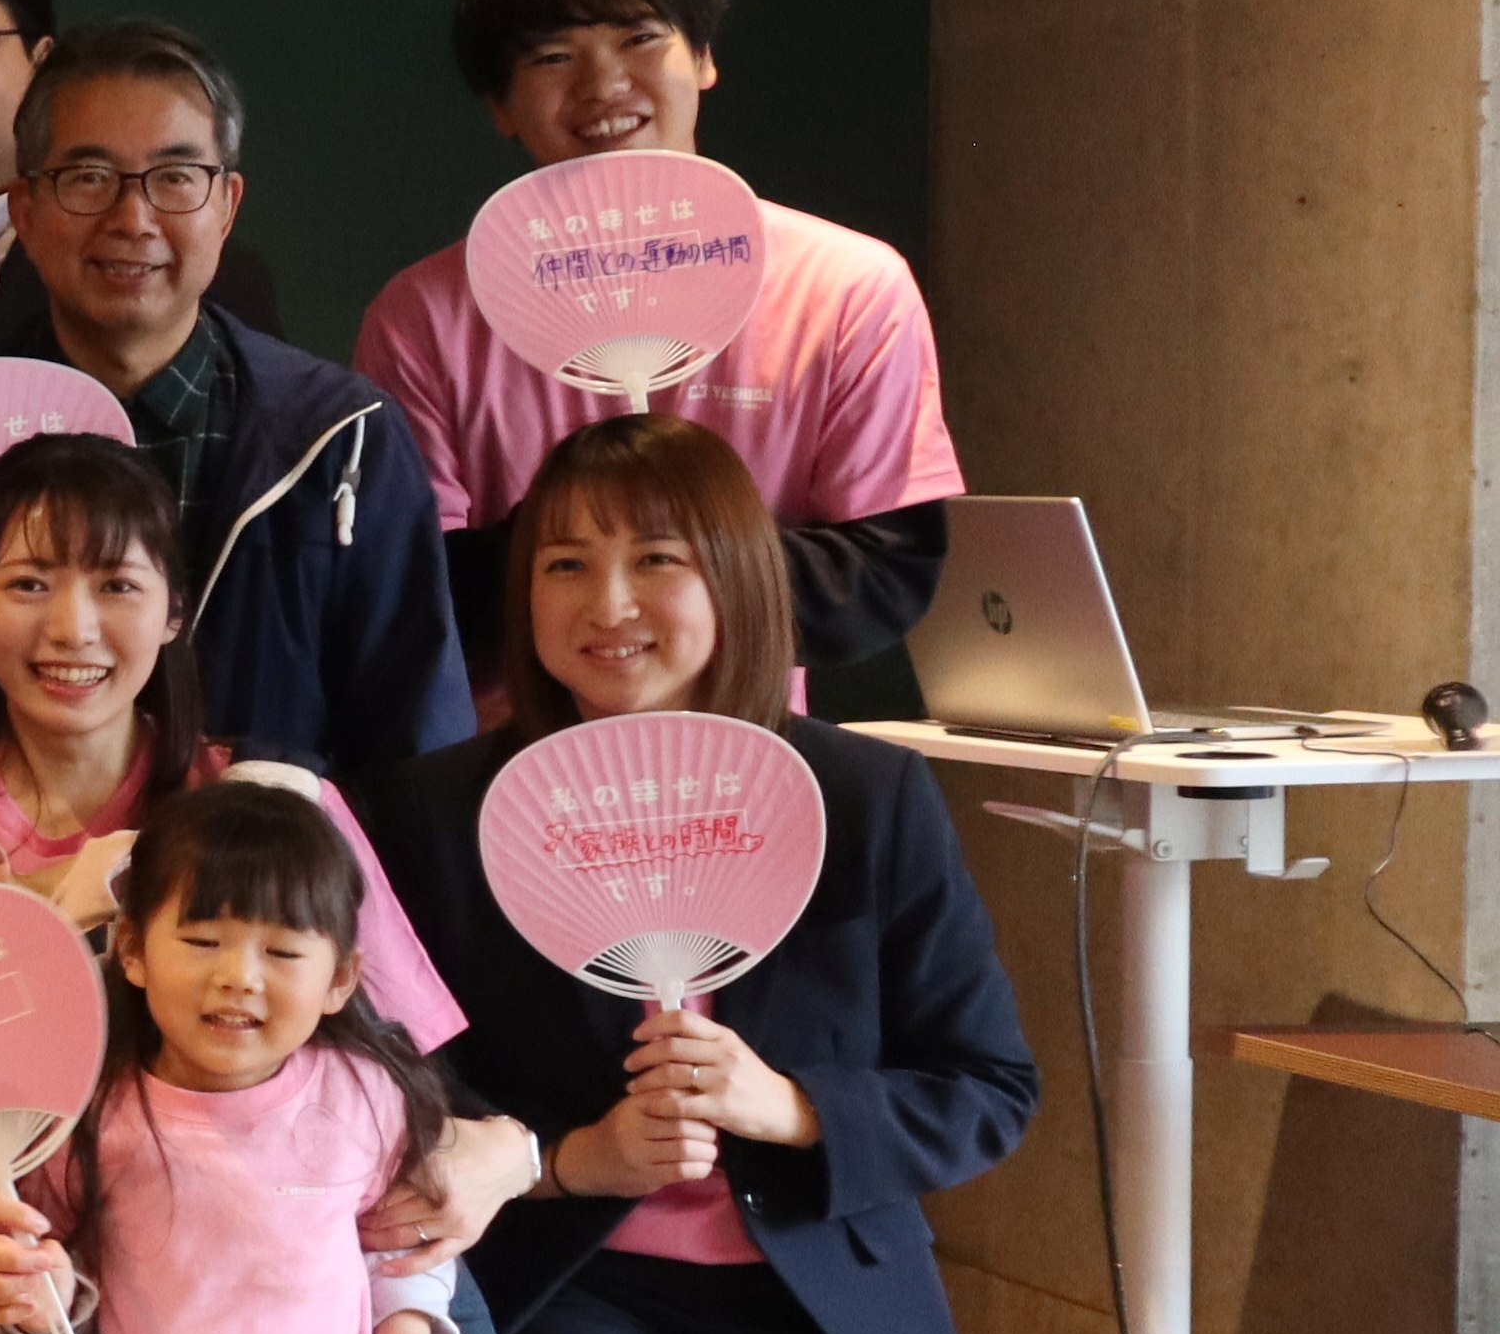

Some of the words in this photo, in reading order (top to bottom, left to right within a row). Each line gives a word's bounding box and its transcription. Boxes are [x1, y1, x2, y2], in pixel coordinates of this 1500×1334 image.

[527, 198, 695, 240] 私の幸せは
[534, 234, 751, 291] 仲間との運動の時間
[576, 286, 658, 314] です。
[549, 772, 743, 815] 私の幸せは
[570, 815, 740, 860] 家族との時間
[601, 873, 698, 904] です。
